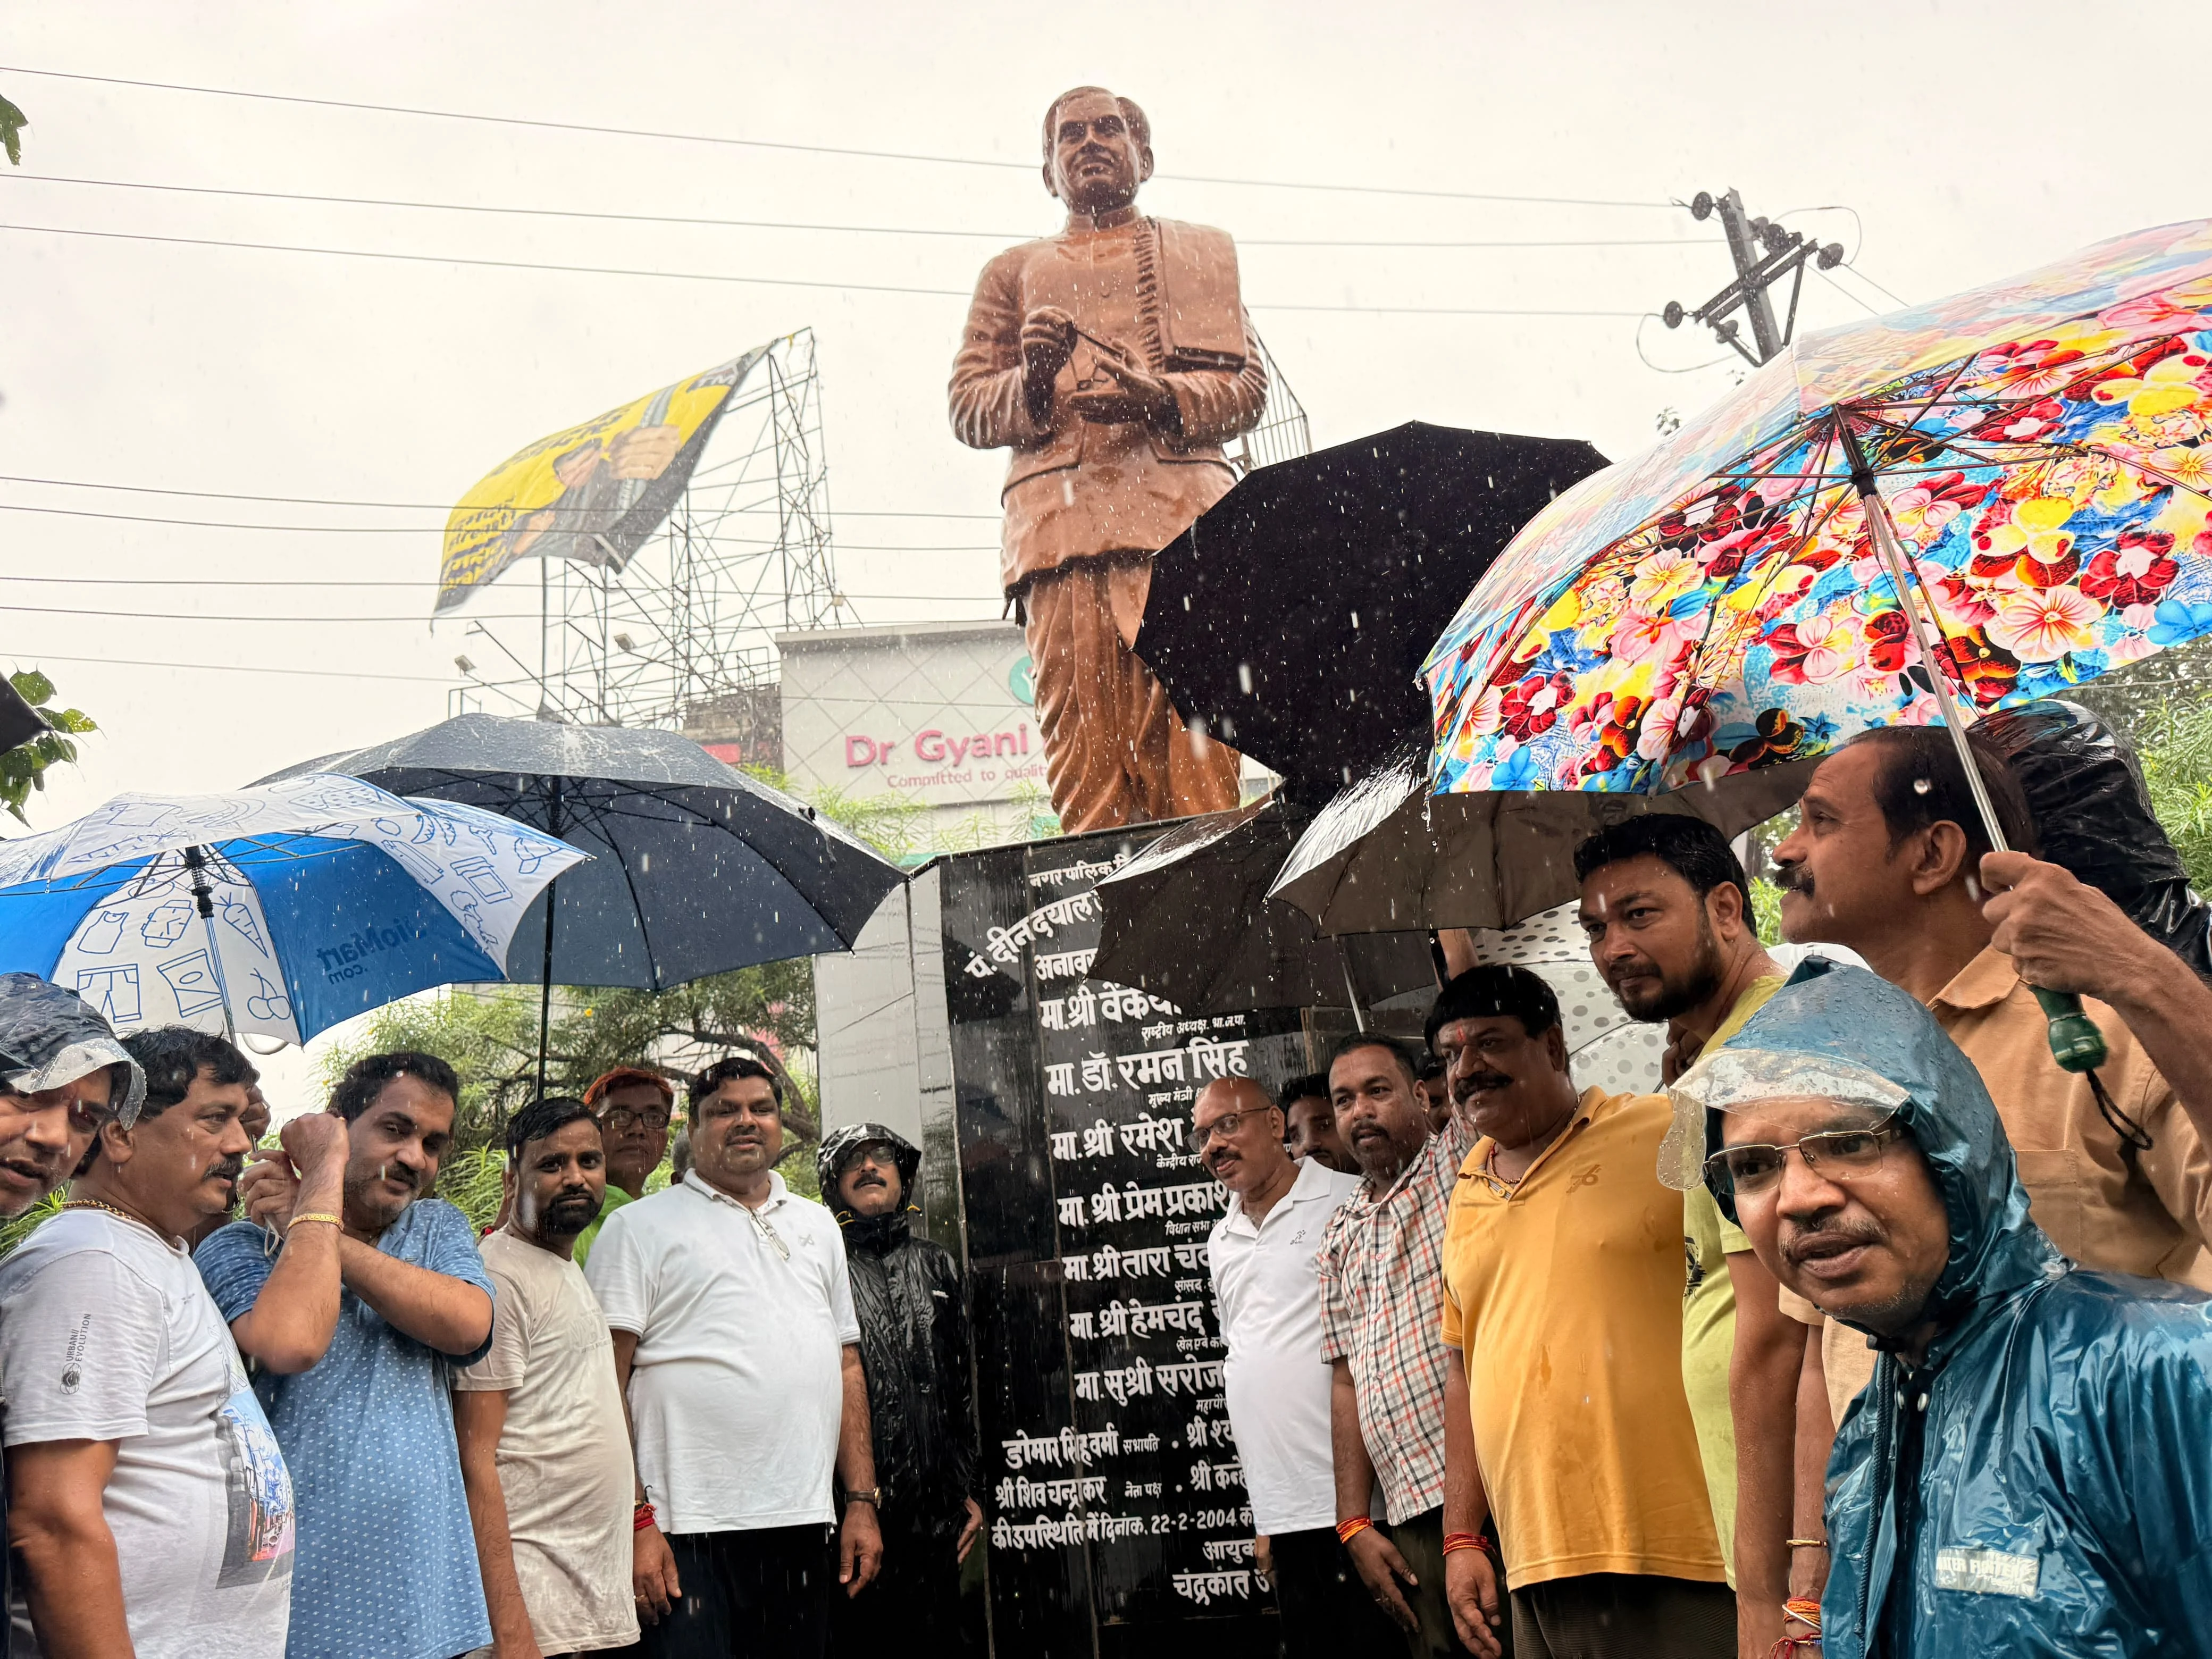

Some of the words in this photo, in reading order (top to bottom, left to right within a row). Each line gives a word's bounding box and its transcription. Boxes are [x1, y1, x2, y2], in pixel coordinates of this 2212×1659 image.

[846, 735, 895, 767] Dr
[915, 723, 1028, 767] Gyani
[887, 770, 972, 788] Committed
[981, 770, 996, 782] to
[1004, 764, 1046, 781] qualit
[1028, 869, 1063, 887] नगर
[1120, 1112, 1184, 1157] रमेश
[75, 1313, 91, 1362] EVOLUTION
[1186, 1415, 1208, 1448] श्री
[1190, 1460, 1211, 1491] श्री
